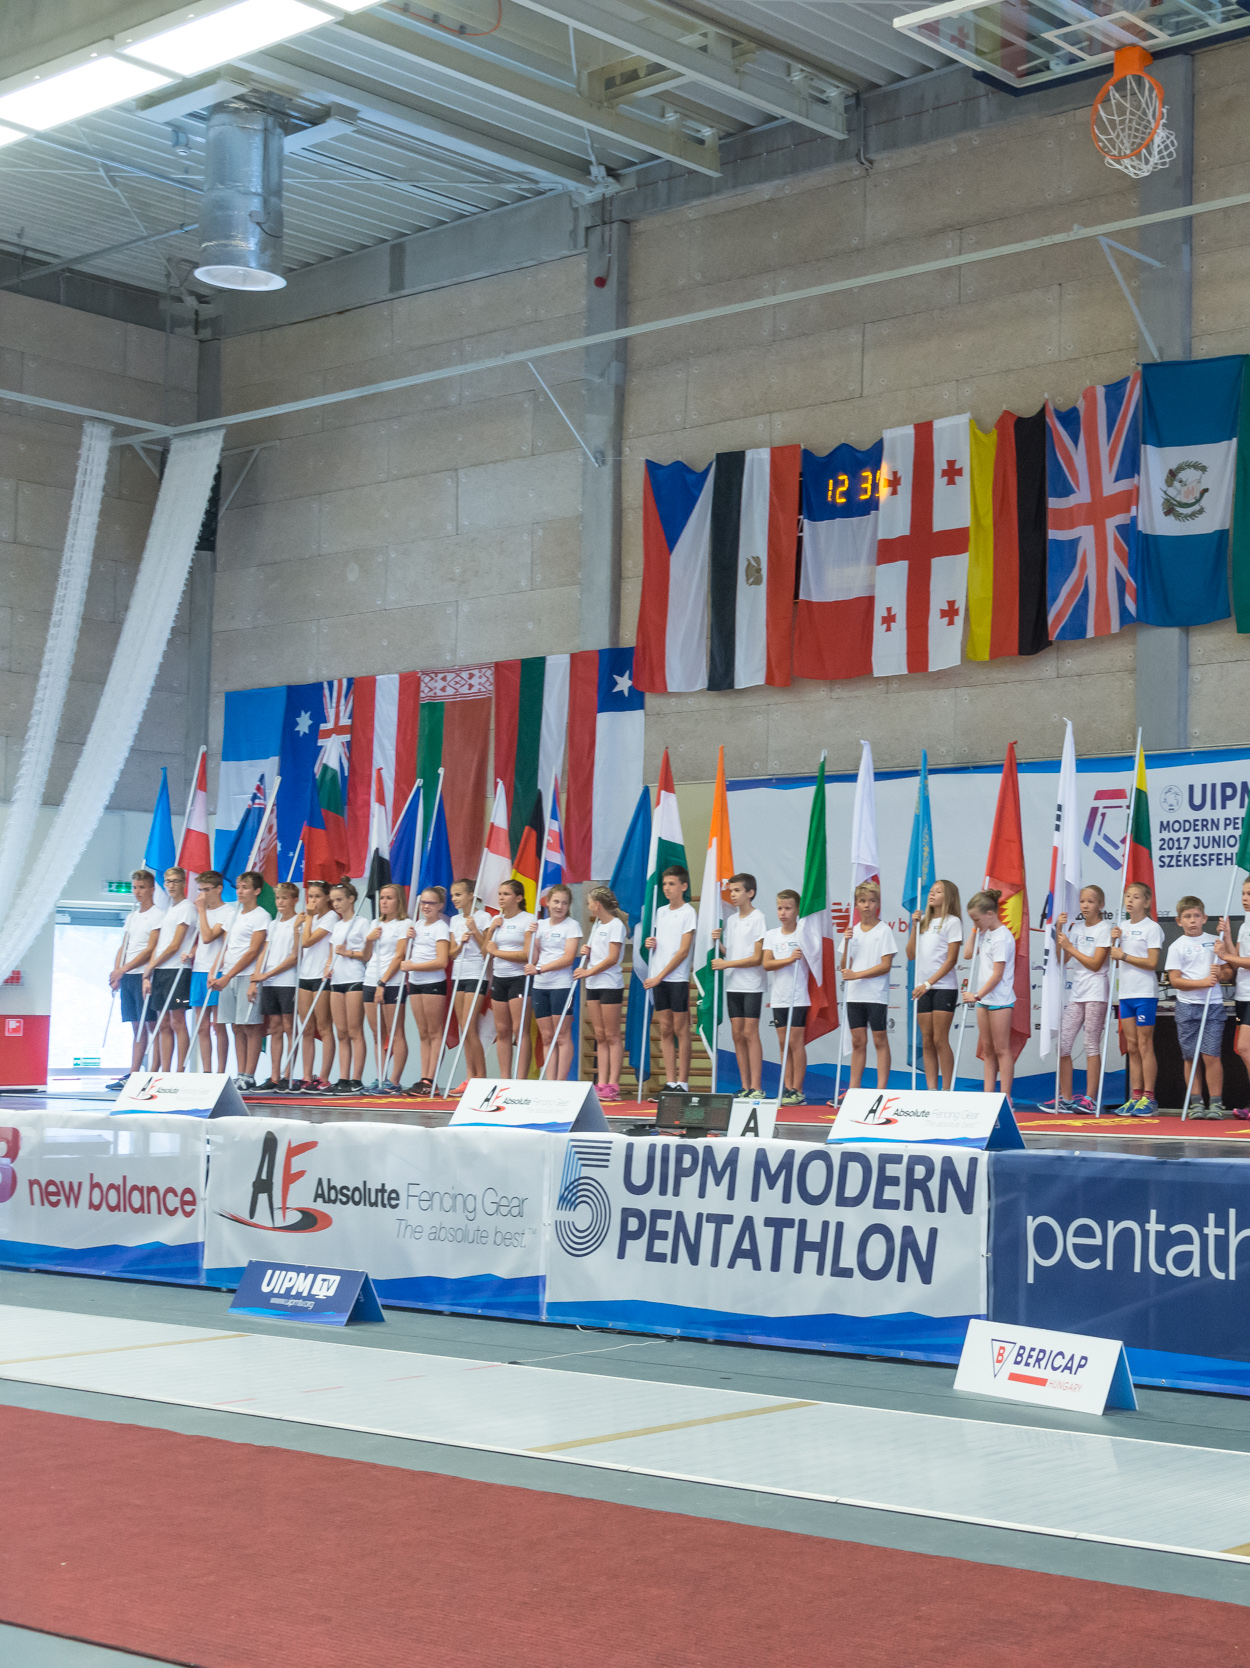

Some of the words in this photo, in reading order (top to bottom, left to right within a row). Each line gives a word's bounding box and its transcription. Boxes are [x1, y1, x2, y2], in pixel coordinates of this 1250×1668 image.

[828, 475, 849, 503] 12
[1159, 817, 1220, 834] MODERN
[1158, 837, 1190, 851] 2017
[1192, 834, 1241, 849] JUNIO
[741, 1108, 759, 1137] A
[892, 1108, 930, 1118] Absolute
[623, 1141, 741, 1201] UIPM
[750, 1147, 979, 1215] MODERN
[28, 1178, 83, 1209] new
[88, 1172, 197, 1218] balance
[313, 1177, 400, 1210] Absolute
[406, 1182, 477, 1222] Fencing
[481, 1187, 528, 1218] Gear
[395, 1218, 424, 1241] The
[428, 1222, 489, 1245] absolute
[617, 1206, 938, 1286] PENTATHLON
[261, 1269, 315, 1296] UIPM
[1013, 1345, 1089, 1376] BERICAP
[1048, 1379, 1084, 1393] HUNGARY
